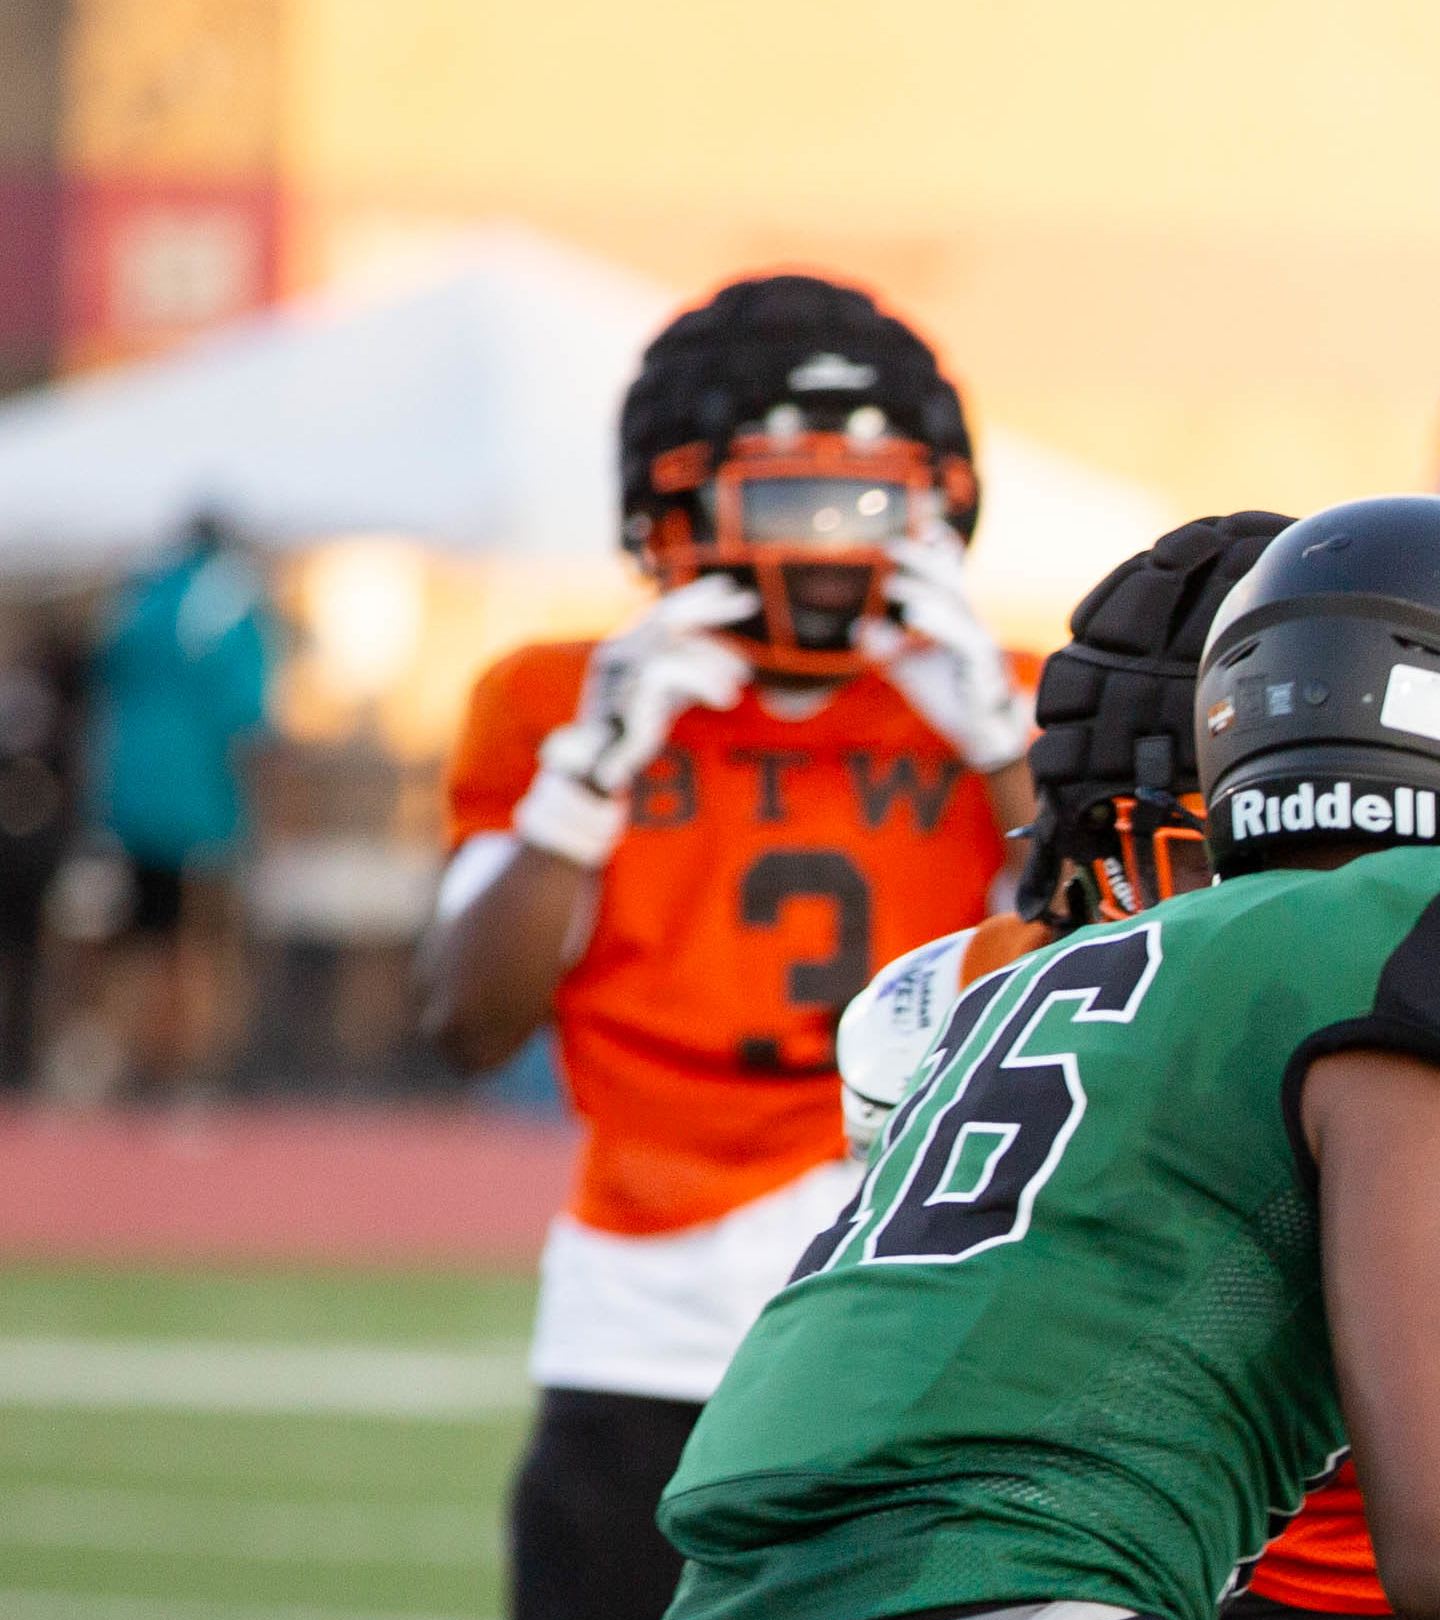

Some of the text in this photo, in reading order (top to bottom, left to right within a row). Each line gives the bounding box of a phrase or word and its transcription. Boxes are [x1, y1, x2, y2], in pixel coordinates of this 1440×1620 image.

[1231, 782, 1437, 841] Riddell
[739, 848, 872, 1074] 3
[785, 921, 1163, 1278] 16
